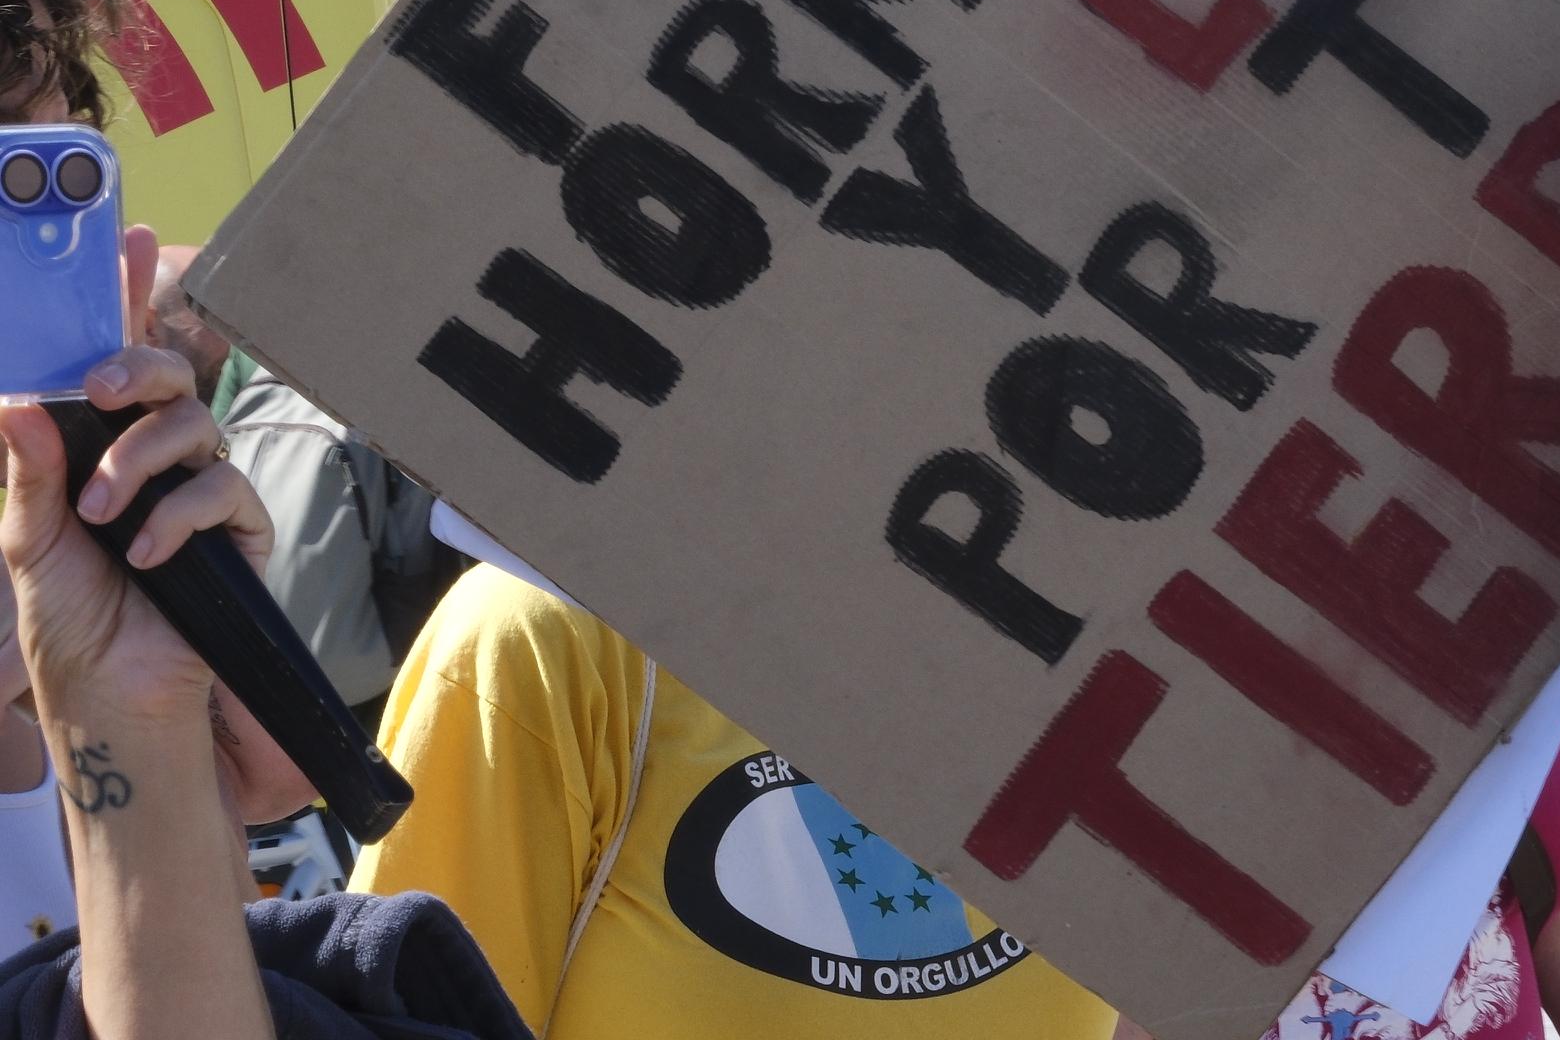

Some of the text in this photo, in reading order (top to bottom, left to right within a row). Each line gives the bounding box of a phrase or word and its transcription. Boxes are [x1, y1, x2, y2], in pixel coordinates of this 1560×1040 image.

[818, 82, 1072, 316] Y
[882, 200, 1319, 668] POR
[744, 755, 796, 788] SER
[810, 932, 1025, 995] UN ORGULLO
